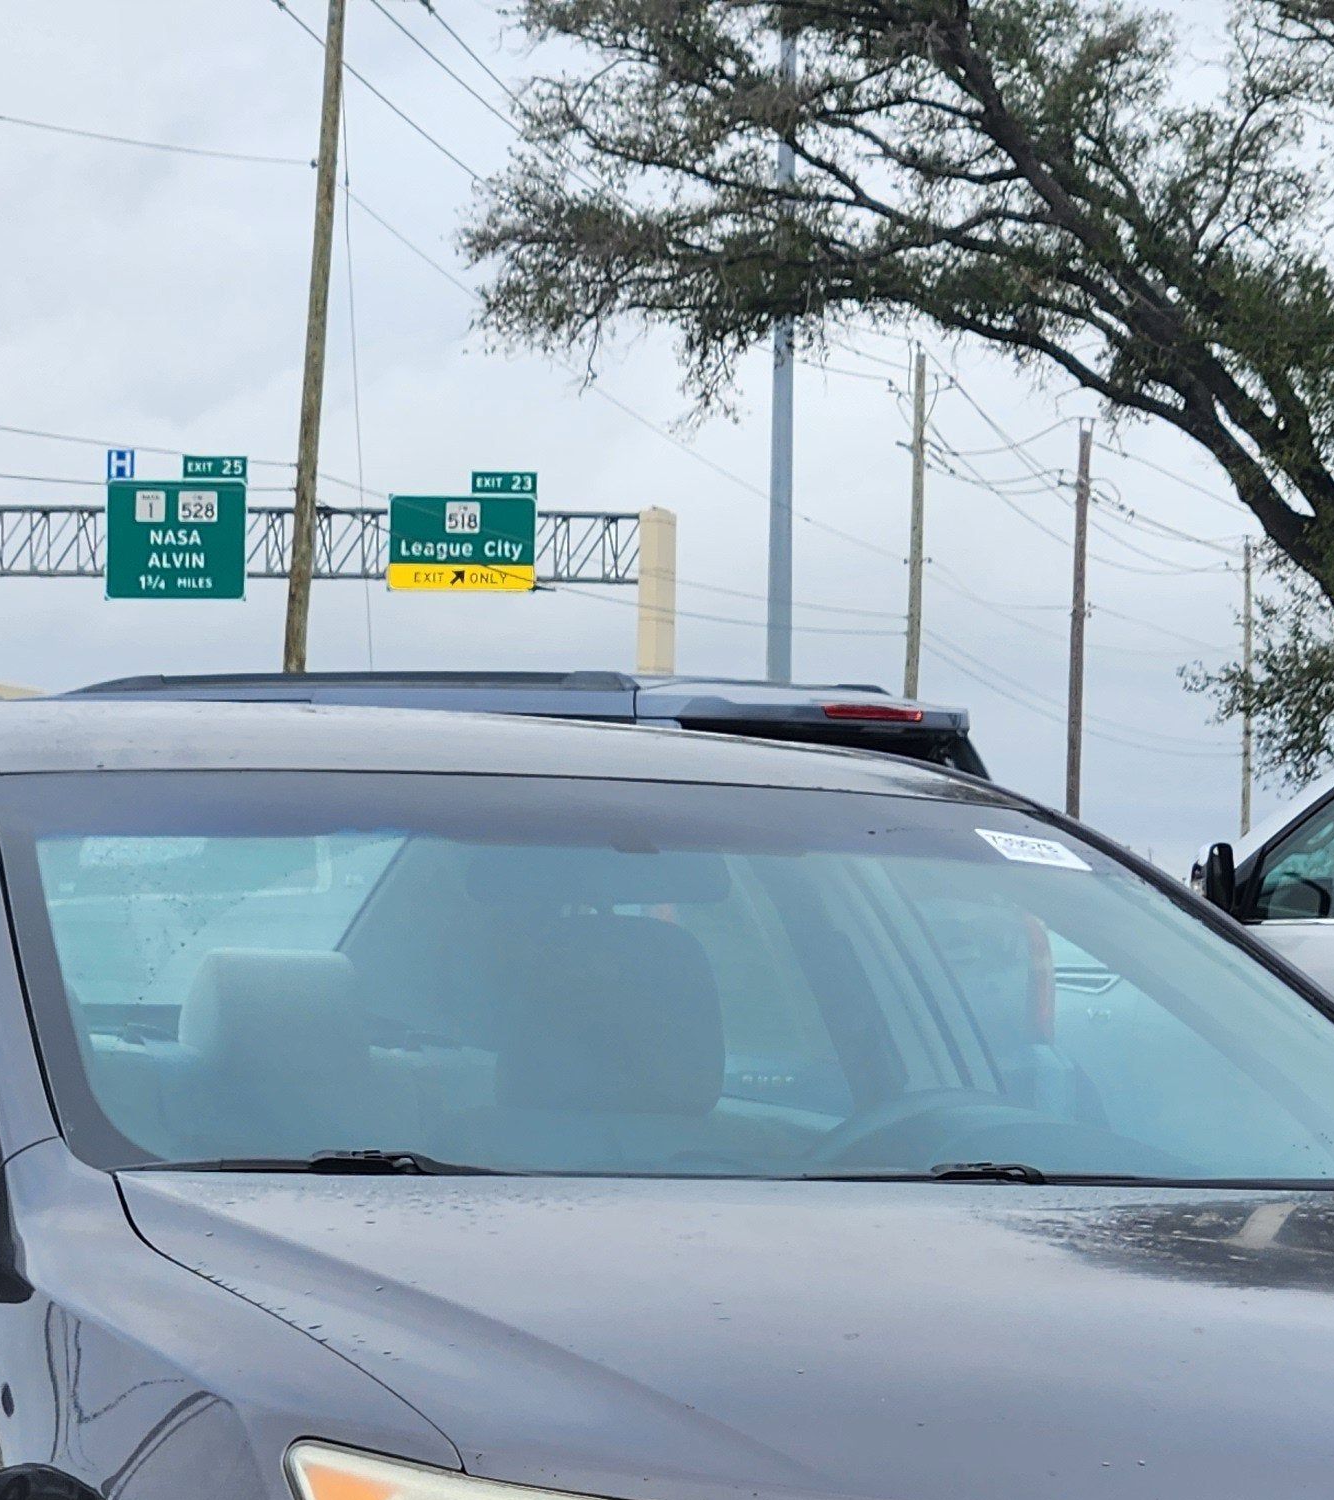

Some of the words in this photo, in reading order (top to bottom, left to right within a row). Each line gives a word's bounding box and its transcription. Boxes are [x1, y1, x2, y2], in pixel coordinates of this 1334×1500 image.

[187, 462, 212, 473] EXIT
[221, 461, 243, 475] 25
[476, 477, 502, 489] EXIT
[511, 475, 533, 491] 23
[148, 502, 153, 518] 1
[181, 502, 215, 519] 528
[448, 512, 478, 529] 518
[150, 529, 201, 546] NASA
[400, 539, 473, 561] League
[484, 539, 523, 561] City
[148, 552, 205, 569] ALVIN
[177, 577, 212, 588] MILES
[414, 572, 444, 583] EXIT
[470, 573, 507, 584] ONLY
